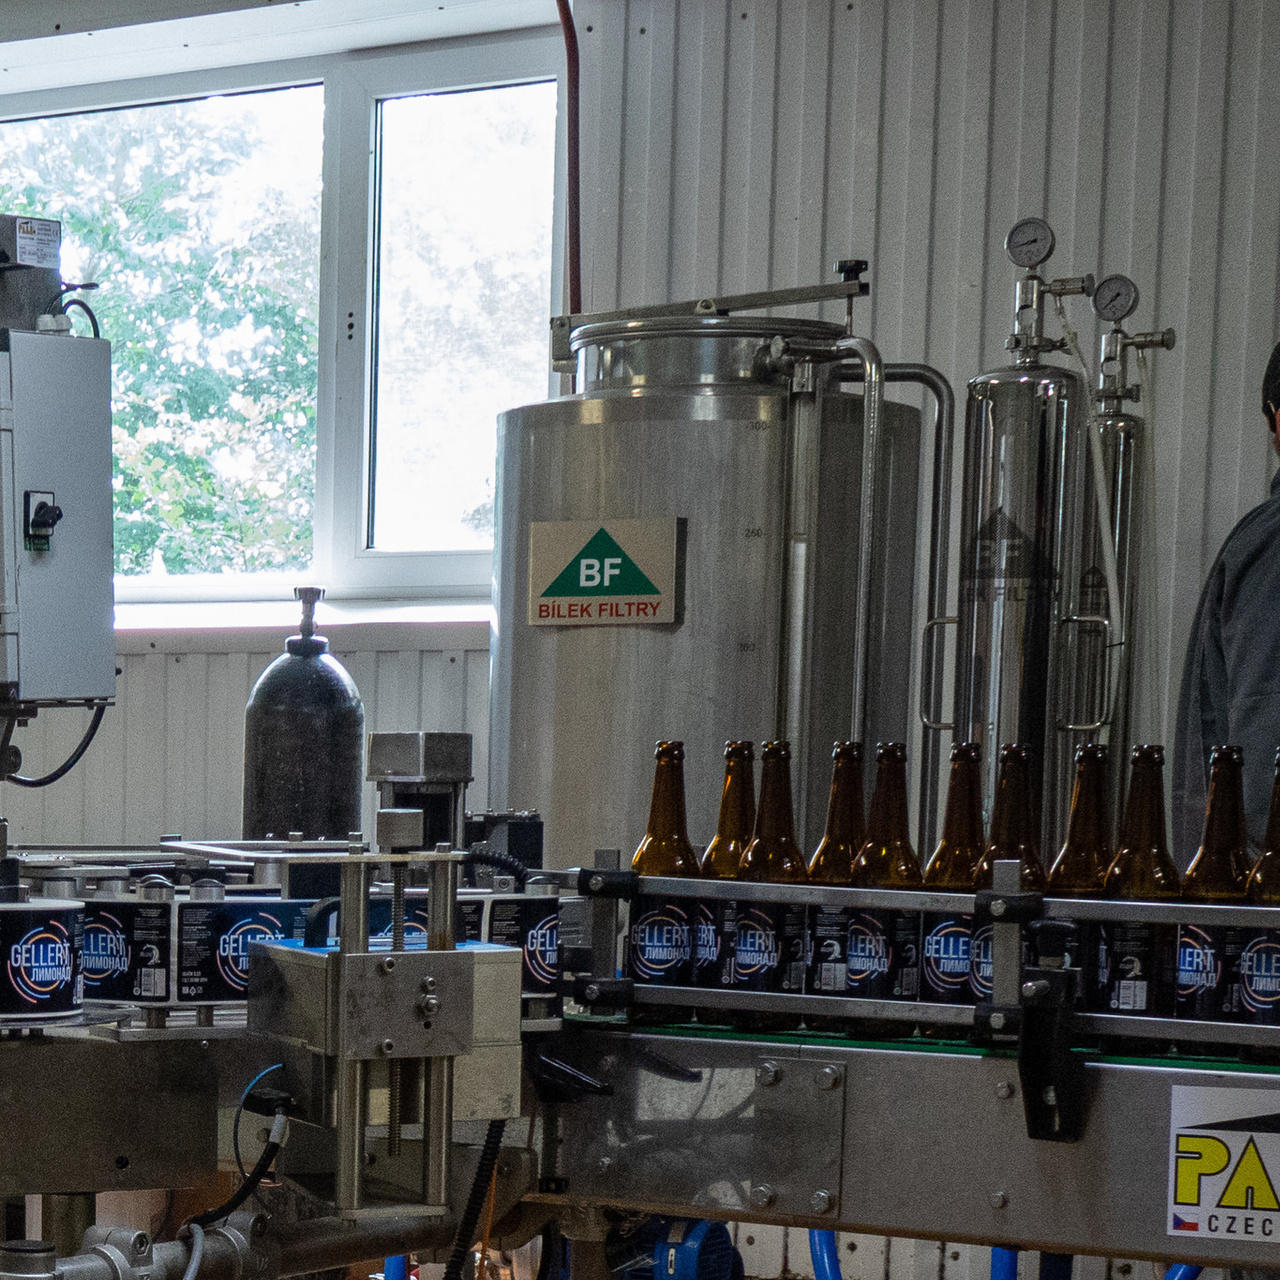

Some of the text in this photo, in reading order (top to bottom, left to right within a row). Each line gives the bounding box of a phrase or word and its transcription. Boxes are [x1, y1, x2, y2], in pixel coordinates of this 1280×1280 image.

[579, 557, 622, 587] BF
[538, 600, 661, 618] BÍLEK FILTRY
[631, 924, 689, 946] GELLERT
[10, 943, 70, 967] GELLERT
[925, 936, 970, 958] GELLE
[30, 967, 71, 982] ЛИМОНАД
[939, 960, 970, 972] ЛИМО
[1207, 1214, 1273, 1236] CZEC
